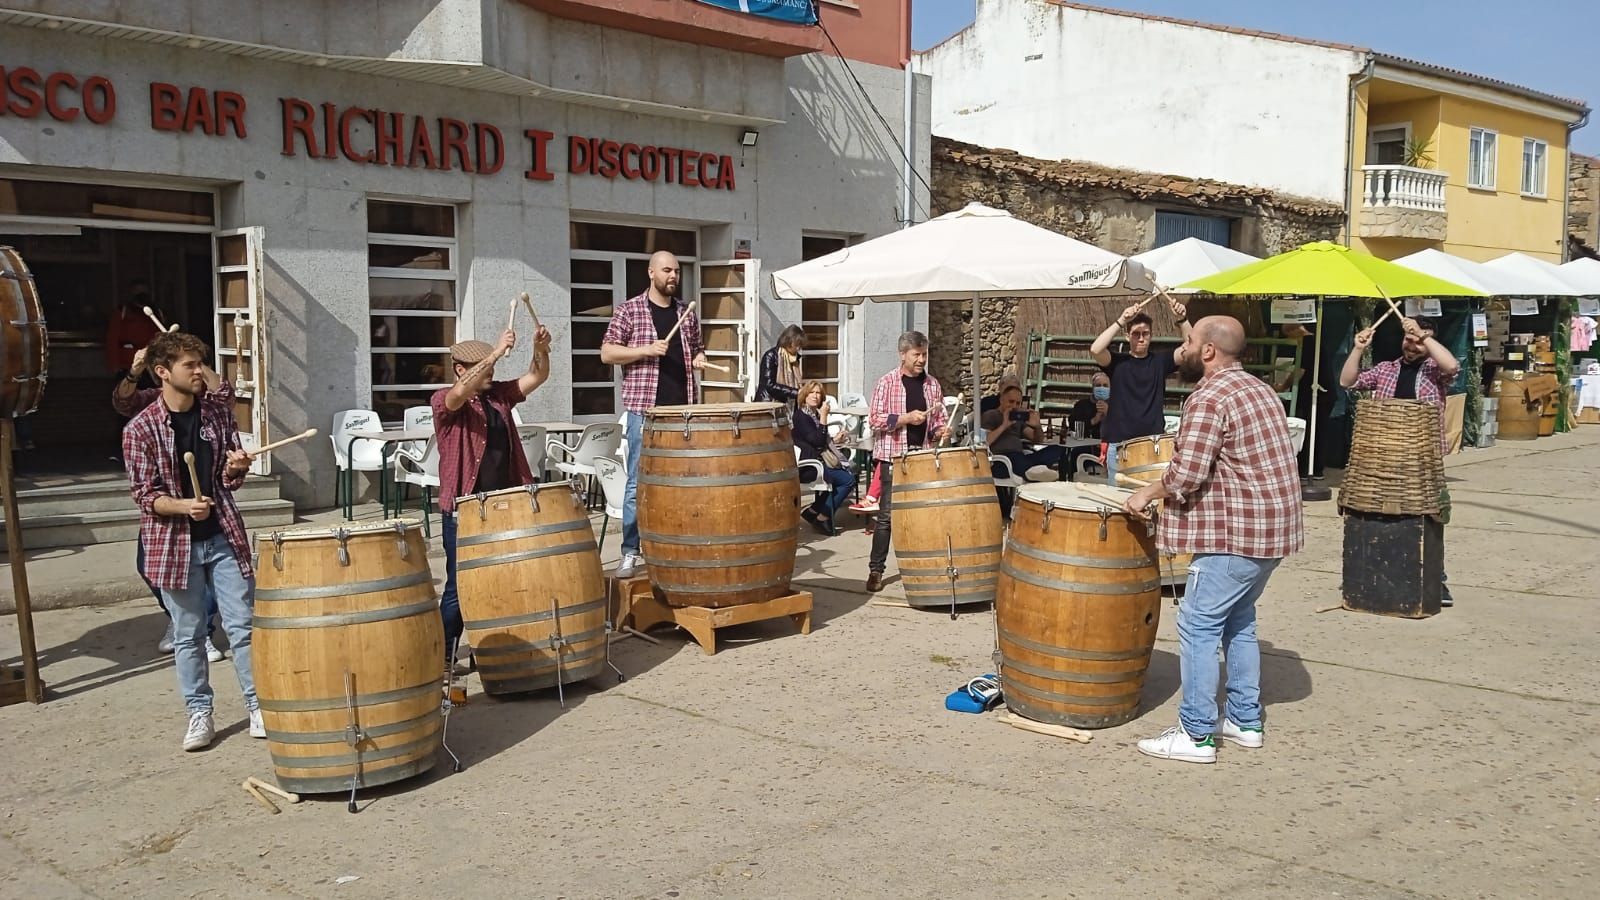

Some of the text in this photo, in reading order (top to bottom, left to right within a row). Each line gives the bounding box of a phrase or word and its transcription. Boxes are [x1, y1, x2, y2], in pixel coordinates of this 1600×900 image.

[150, 82, 247, 139] BAR
[279, 97, 505, 175] RICHARD
[524, 129, 555, 181] I
[568, 135, 736, 191] DISCOTECA
